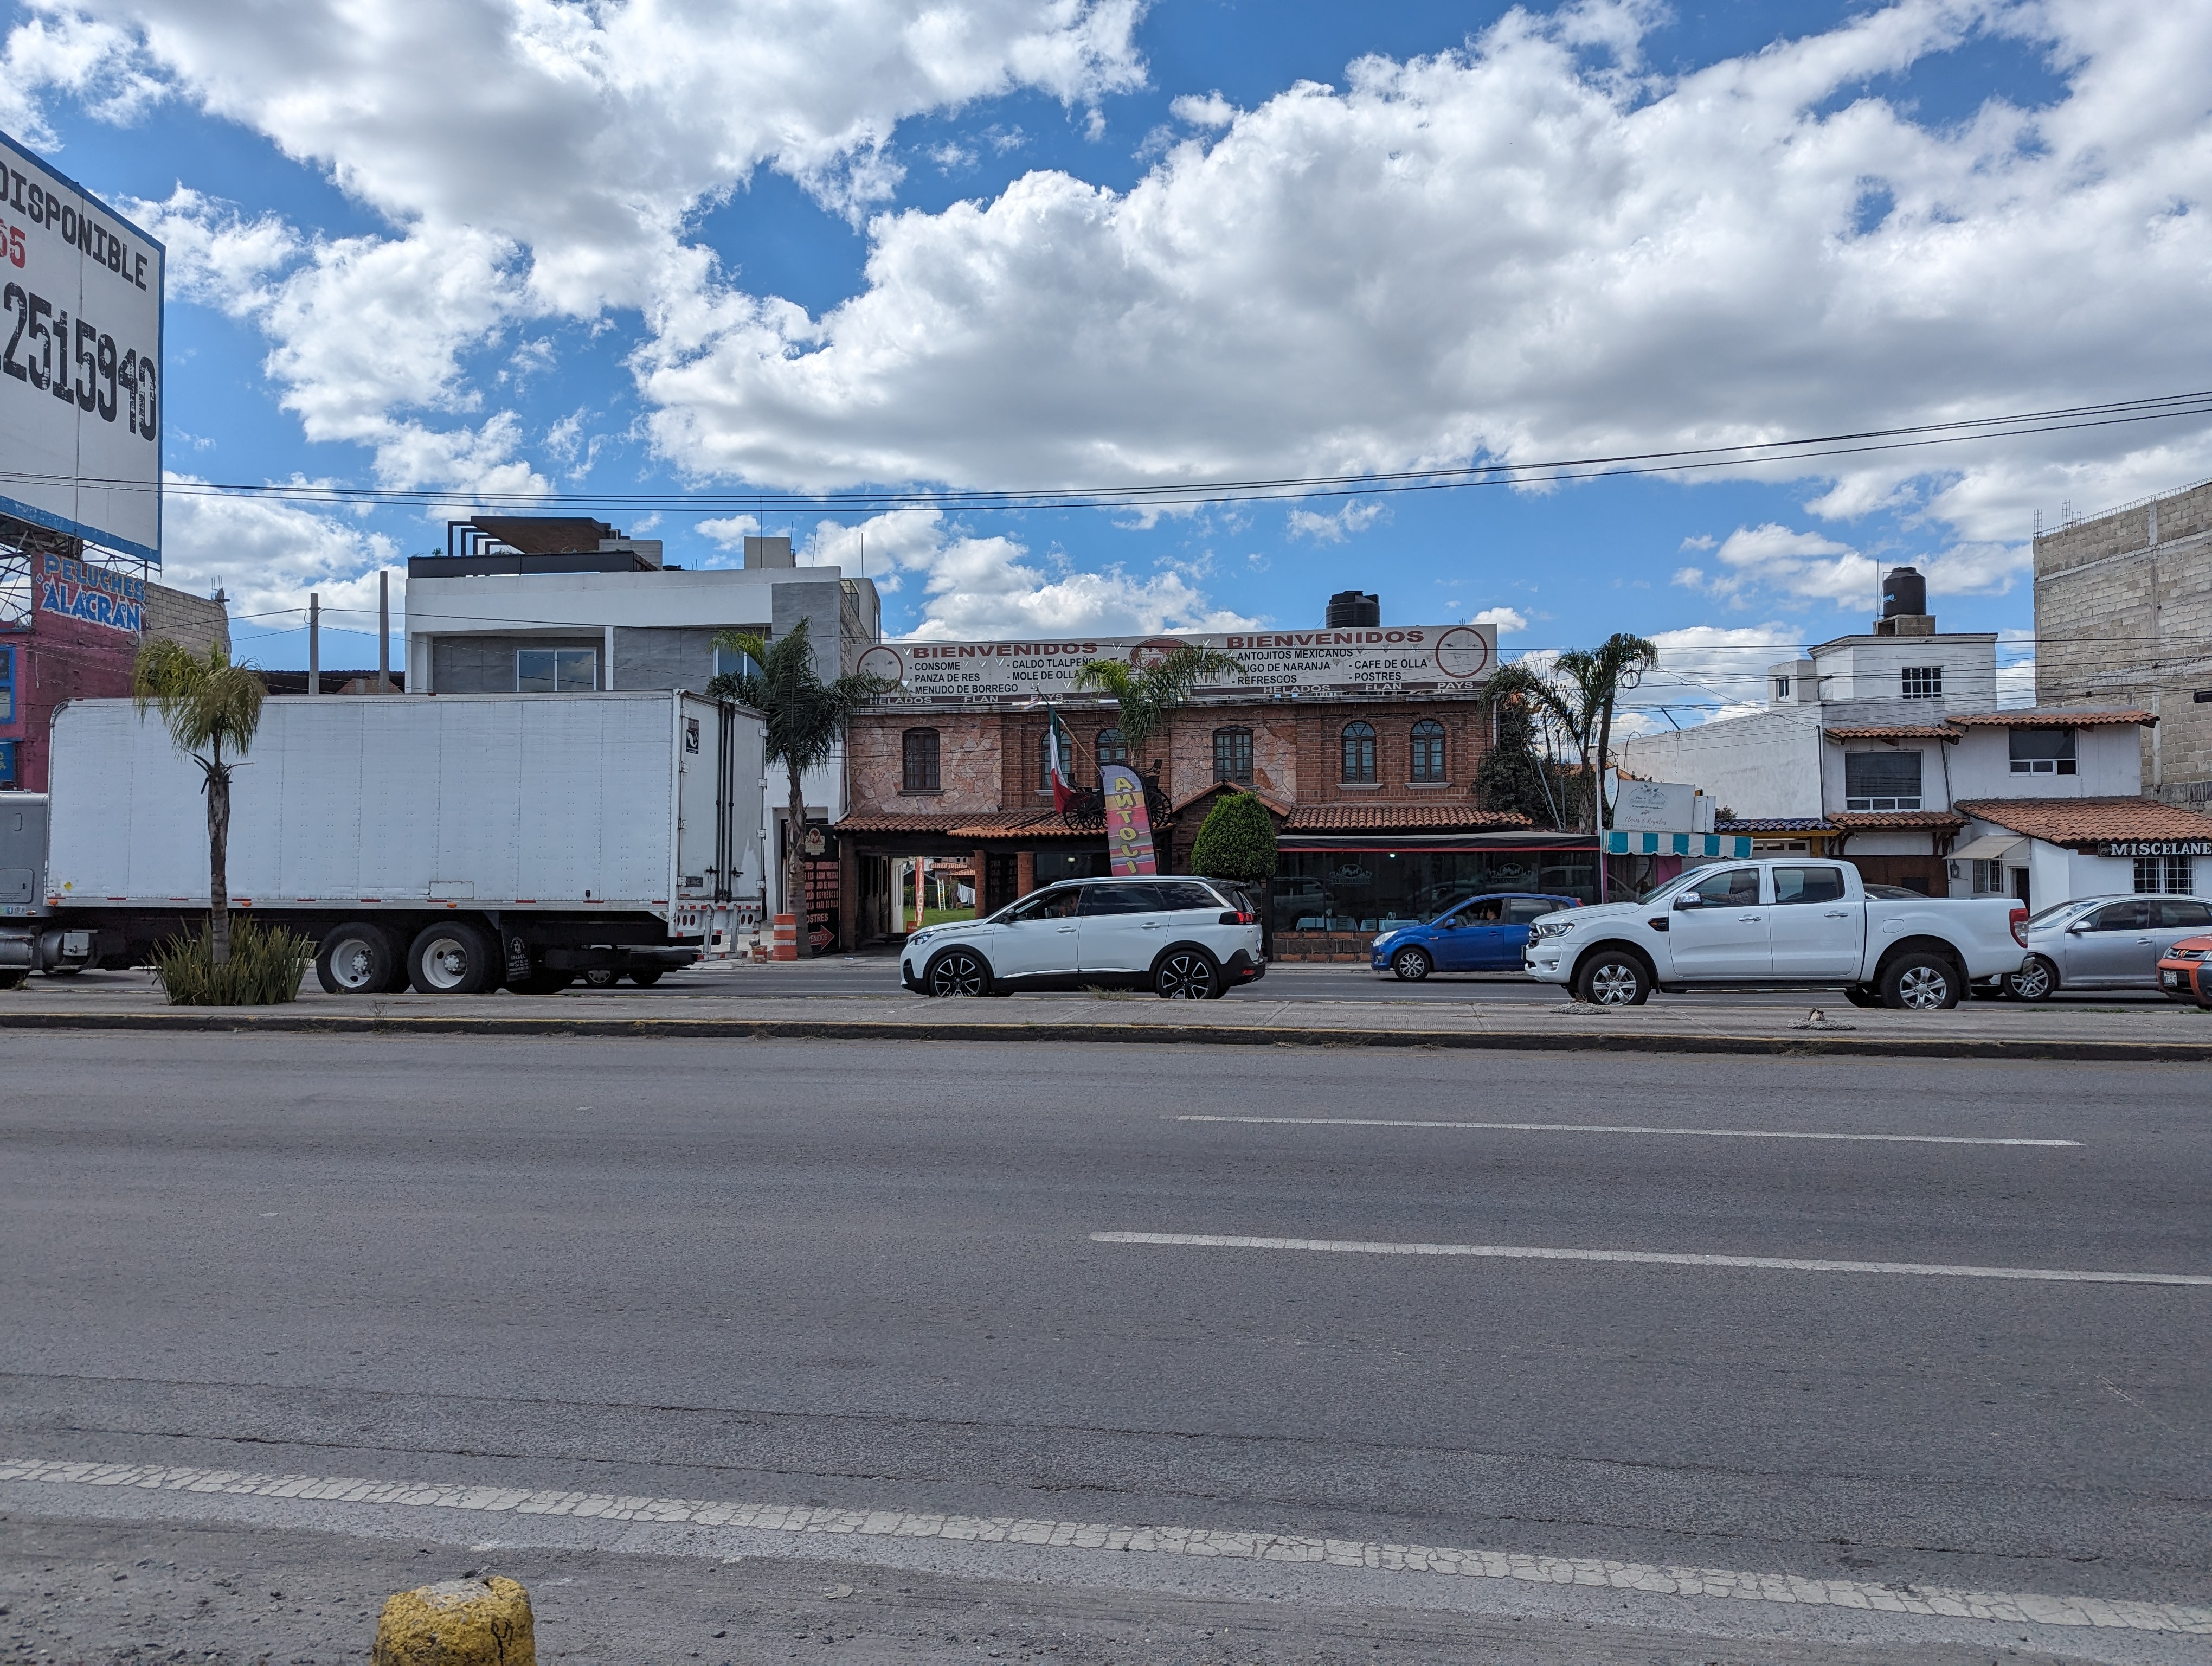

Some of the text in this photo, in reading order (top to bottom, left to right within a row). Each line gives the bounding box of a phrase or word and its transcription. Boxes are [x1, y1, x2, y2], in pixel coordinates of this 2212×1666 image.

[0, 161, 147, 292] DISPONIBLE
[0, 281, 157, 441] 2515940
[43, 552, 145, 602] PELUCHES
[1227, 630, 1424, 649] BIENVENIDOS
[914, 642, 1098, 658] BIENVENIDOS
[1237, 649, 1353, 661] ANTOJITOS MEXICANOS
[915, 662, 961, 671] CONSOME
[1012, 656, 1095, 669] CALDO TLALPEÑO
[1268, 663, 1281, 672] DE
[1283, 662, 1330, 671] NARANJA
[1354, 658, 1427, 669] CAFE DE OLLA
[915, 672, 980, 683] PANZA DE RES
[1013, 670, 1080, 681] MOLE DE OLLA
[1238, 674, 1297, 685] REFRESCOS
[1354, 672, 1401, 681] POSTRES
[915, 683, 1018, 694] MENUDO DE BORREGO
[1263, 685, 1330, 694] HELADOS
[2110, 842, 2212, 856] MISCELANE
[807, 913, 828, 924] OSTRES
